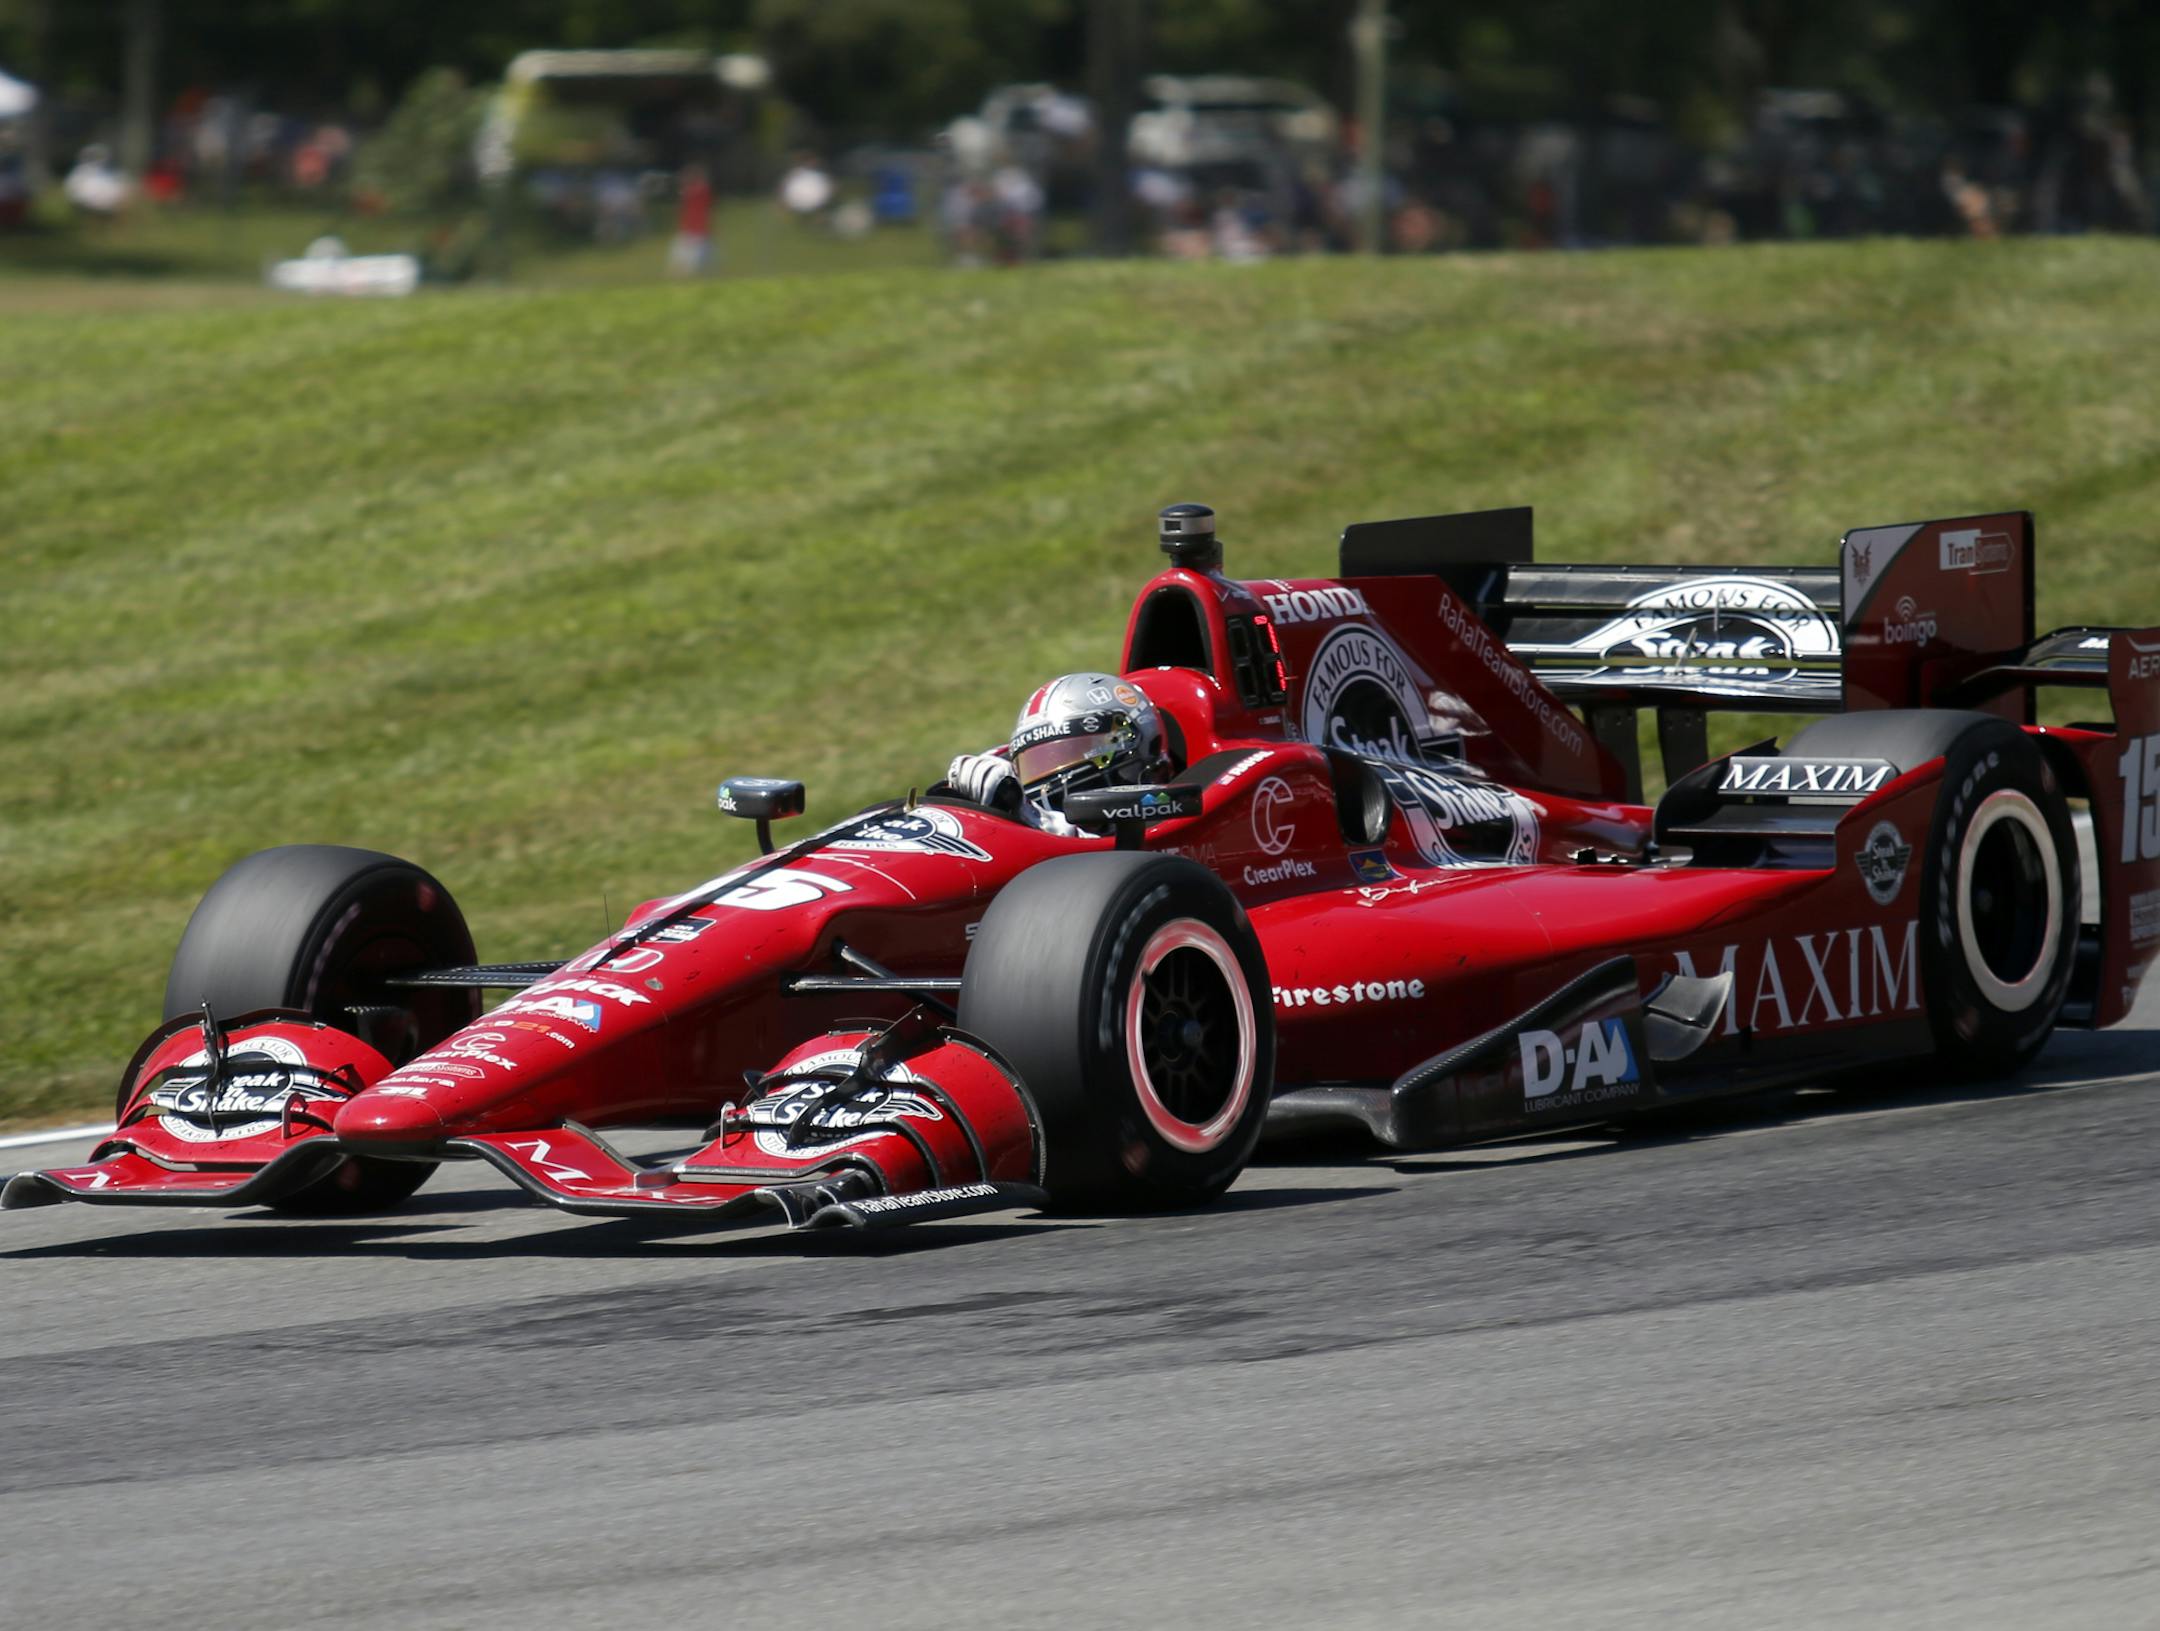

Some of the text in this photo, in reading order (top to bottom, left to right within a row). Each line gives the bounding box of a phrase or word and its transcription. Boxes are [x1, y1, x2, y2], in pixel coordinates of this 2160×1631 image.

[1759, 594, 1812, 632] FOR
[1884, 616, 1938, 648] boingo
[1312, 640, 1407, 713] FAMOUS FOR
[1437, 593, 1584, 758] RahalTeamStore.com
[1033, 721, 1072, 742] SHAKE
[1718, 763, 1890, 793] MAXIM
[1102, 800, 1184, 820] valpak
[1405, 771, 1512, 830] Shake
[1243, 858, 1317, 886] ClearPlex
[1673, 919, 1921, 1036] MAXIM
[231, 1070, 286, 1088] eak
[1523, 1084, 1641, 1114] LUBRICANT COMPANY
[776, 1102, 863, 1129] Sake
[851, 1184, 999, 1214] RahalTeamStore.com
